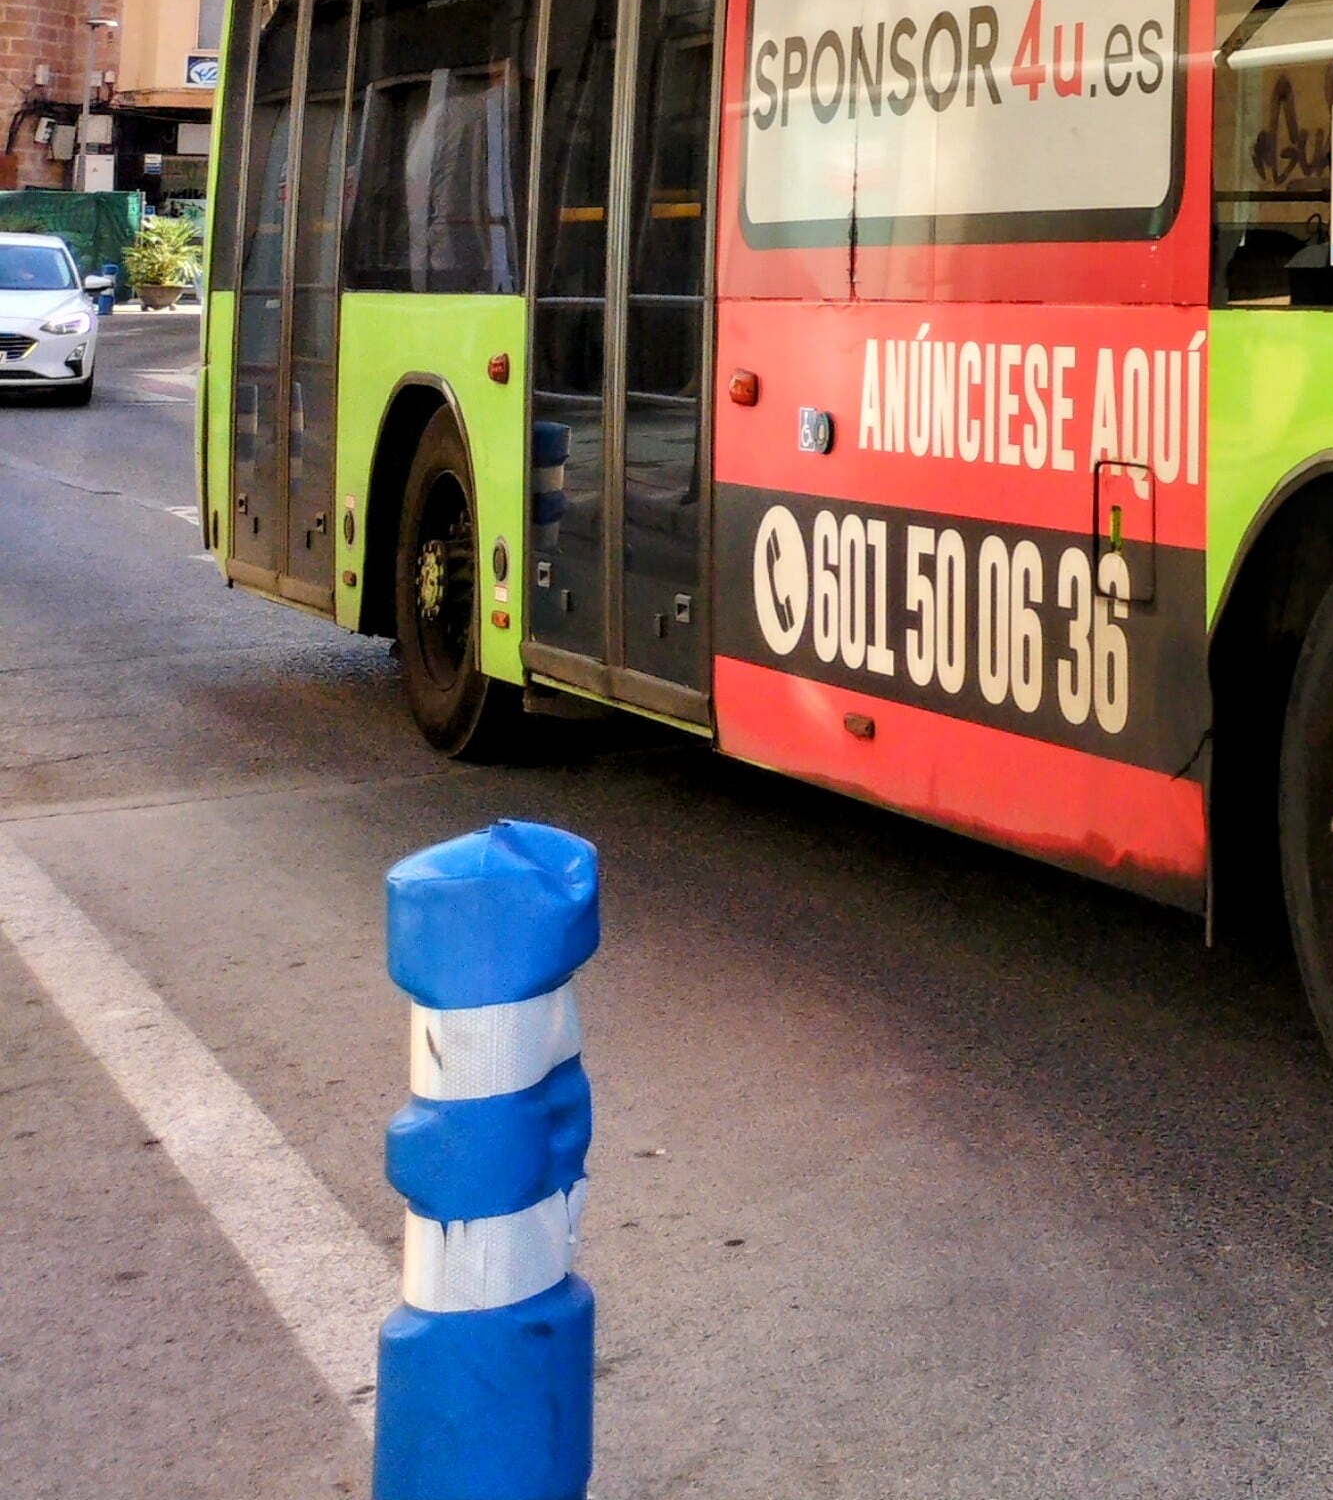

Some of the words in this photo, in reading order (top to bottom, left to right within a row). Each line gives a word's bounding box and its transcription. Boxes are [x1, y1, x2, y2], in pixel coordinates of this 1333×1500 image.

[859, 323, 1076, 472] ANÚNCIESE
[1090, 330, 1206, 499] AQUÍ
[813, 510, 895, 677] 601
[906, 524, 967, 694] 50
[978, 535, 1043, 713] 06
[1057, 547, 1130, 735] 36
